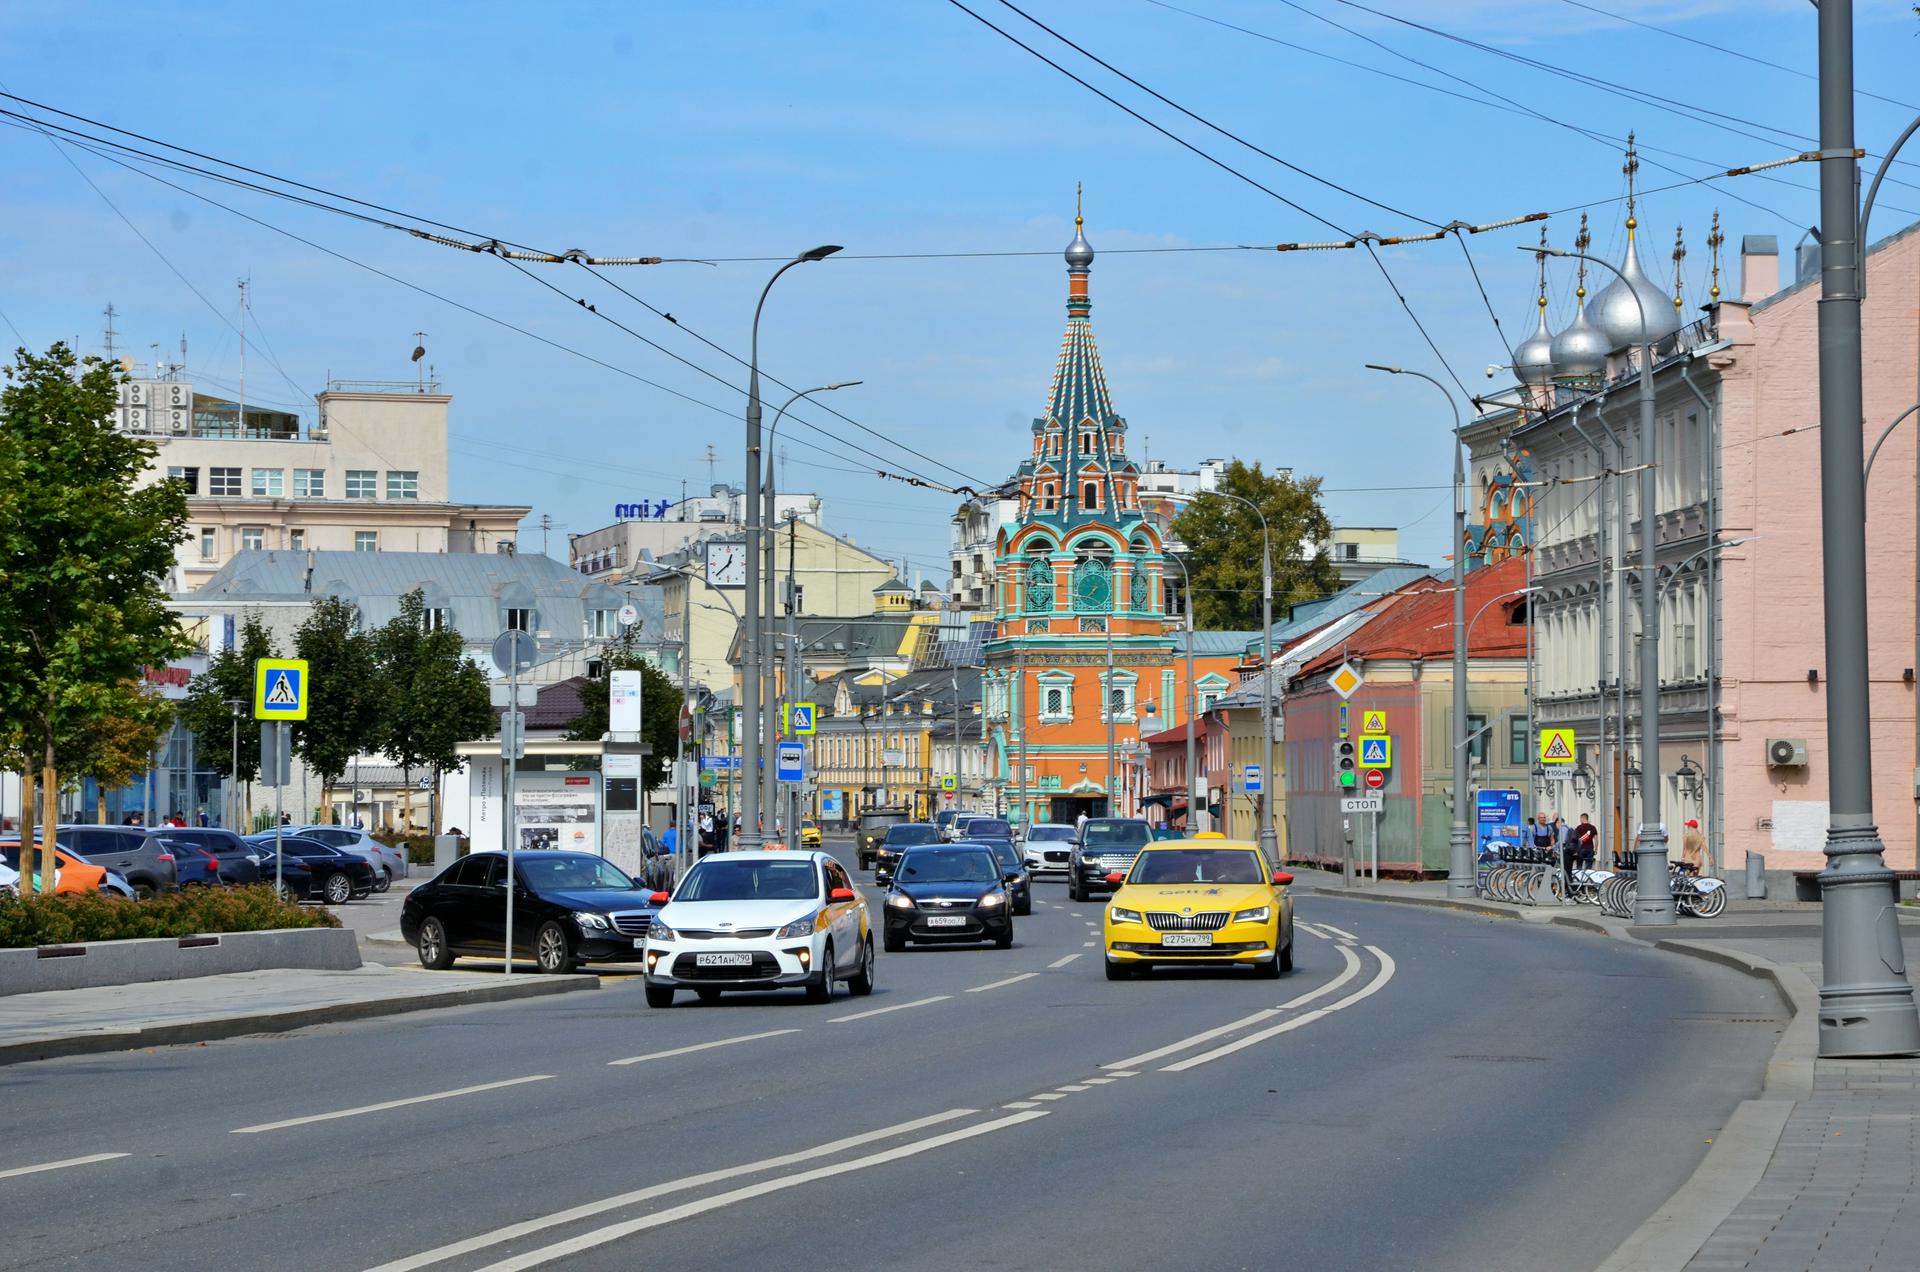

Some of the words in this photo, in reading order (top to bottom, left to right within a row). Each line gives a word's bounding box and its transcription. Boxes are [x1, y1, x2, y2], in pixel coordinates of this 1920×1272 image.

[1506, 793, 1520, 801] ВТБ
[1347, 800, 1377, 810] СТОП
[1164, 935, 1196, 944] С275НХ
[1198, 934, 1210, 942] 799
[699, 954, 735, 965] Р621АН
[736, 954, 750, 962] 790
